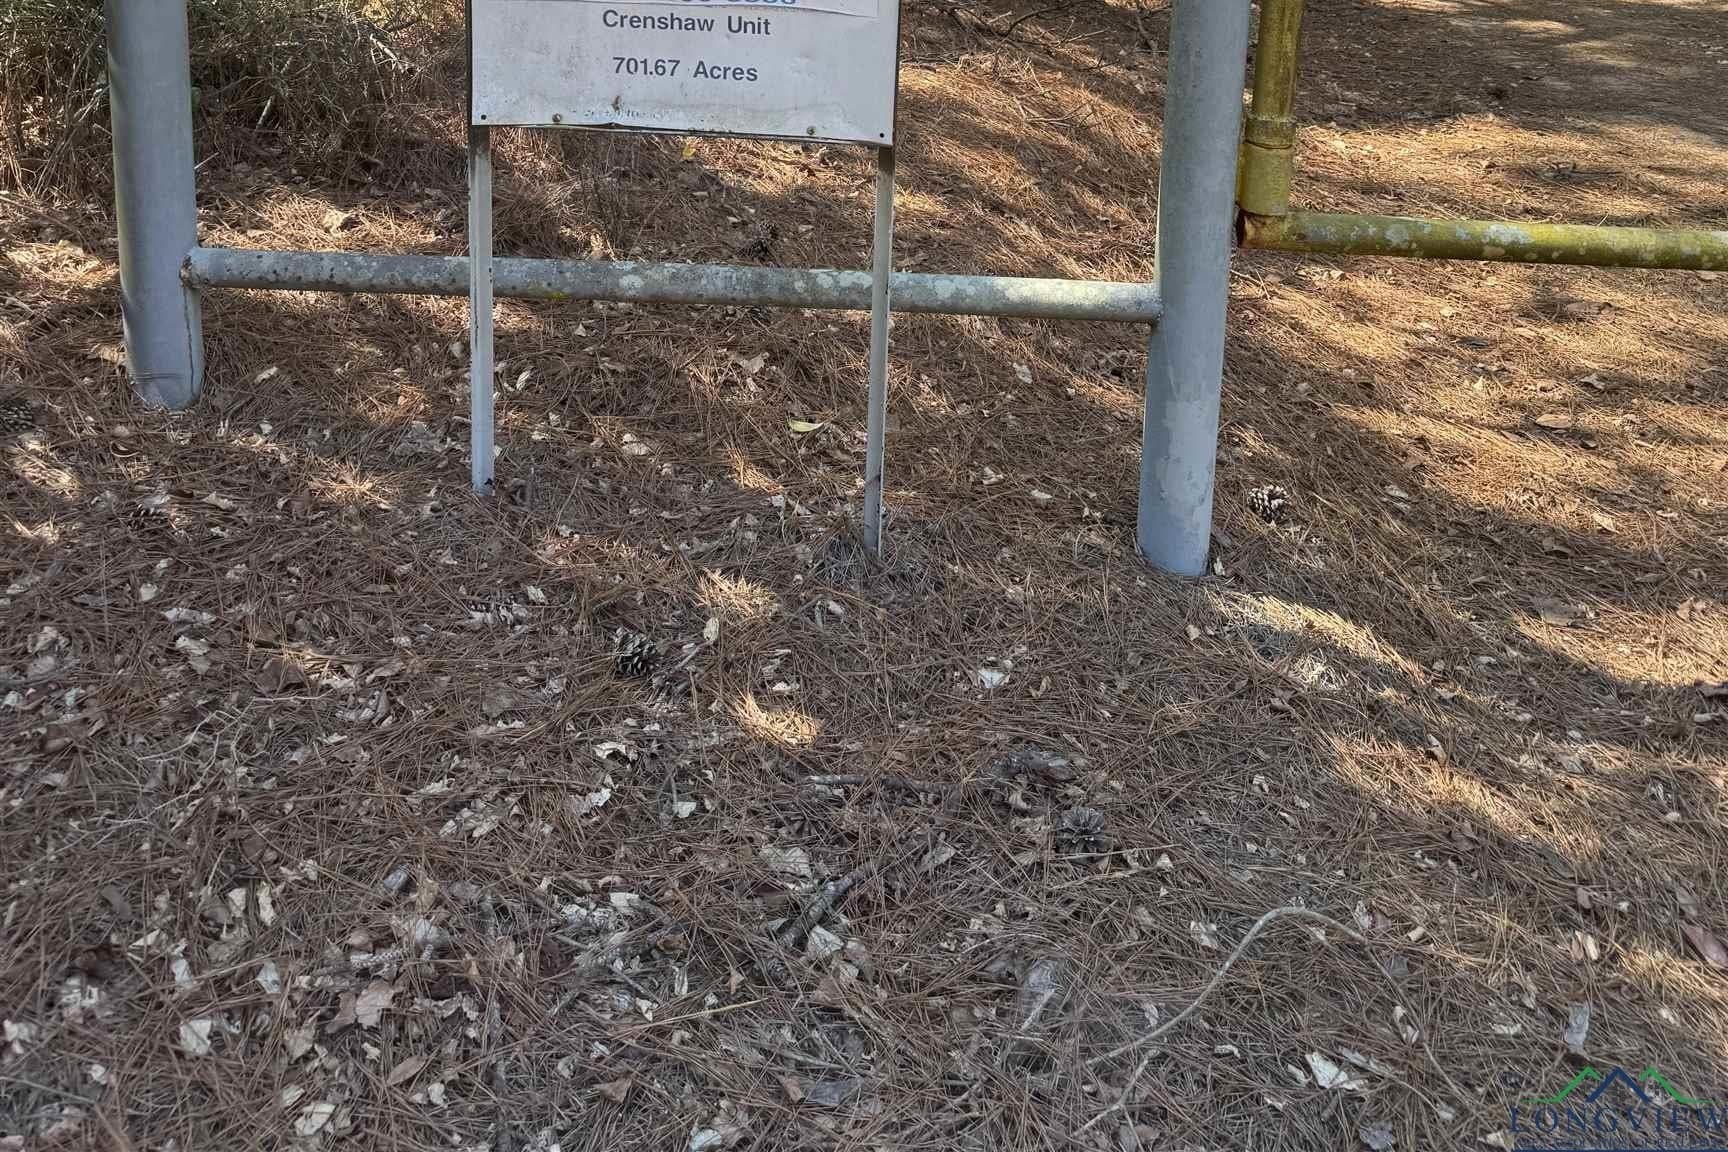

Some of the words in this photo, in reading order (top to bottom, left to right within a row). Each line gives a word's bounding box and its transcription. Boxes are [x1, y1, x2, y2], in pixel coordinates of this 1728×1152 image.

[602, 9, 715, 33] Crenshaw
[727, 14, 771, 36] Unit
[612, 56, 681, 78] 701.67
[693, 60, 758, 83] Acres
